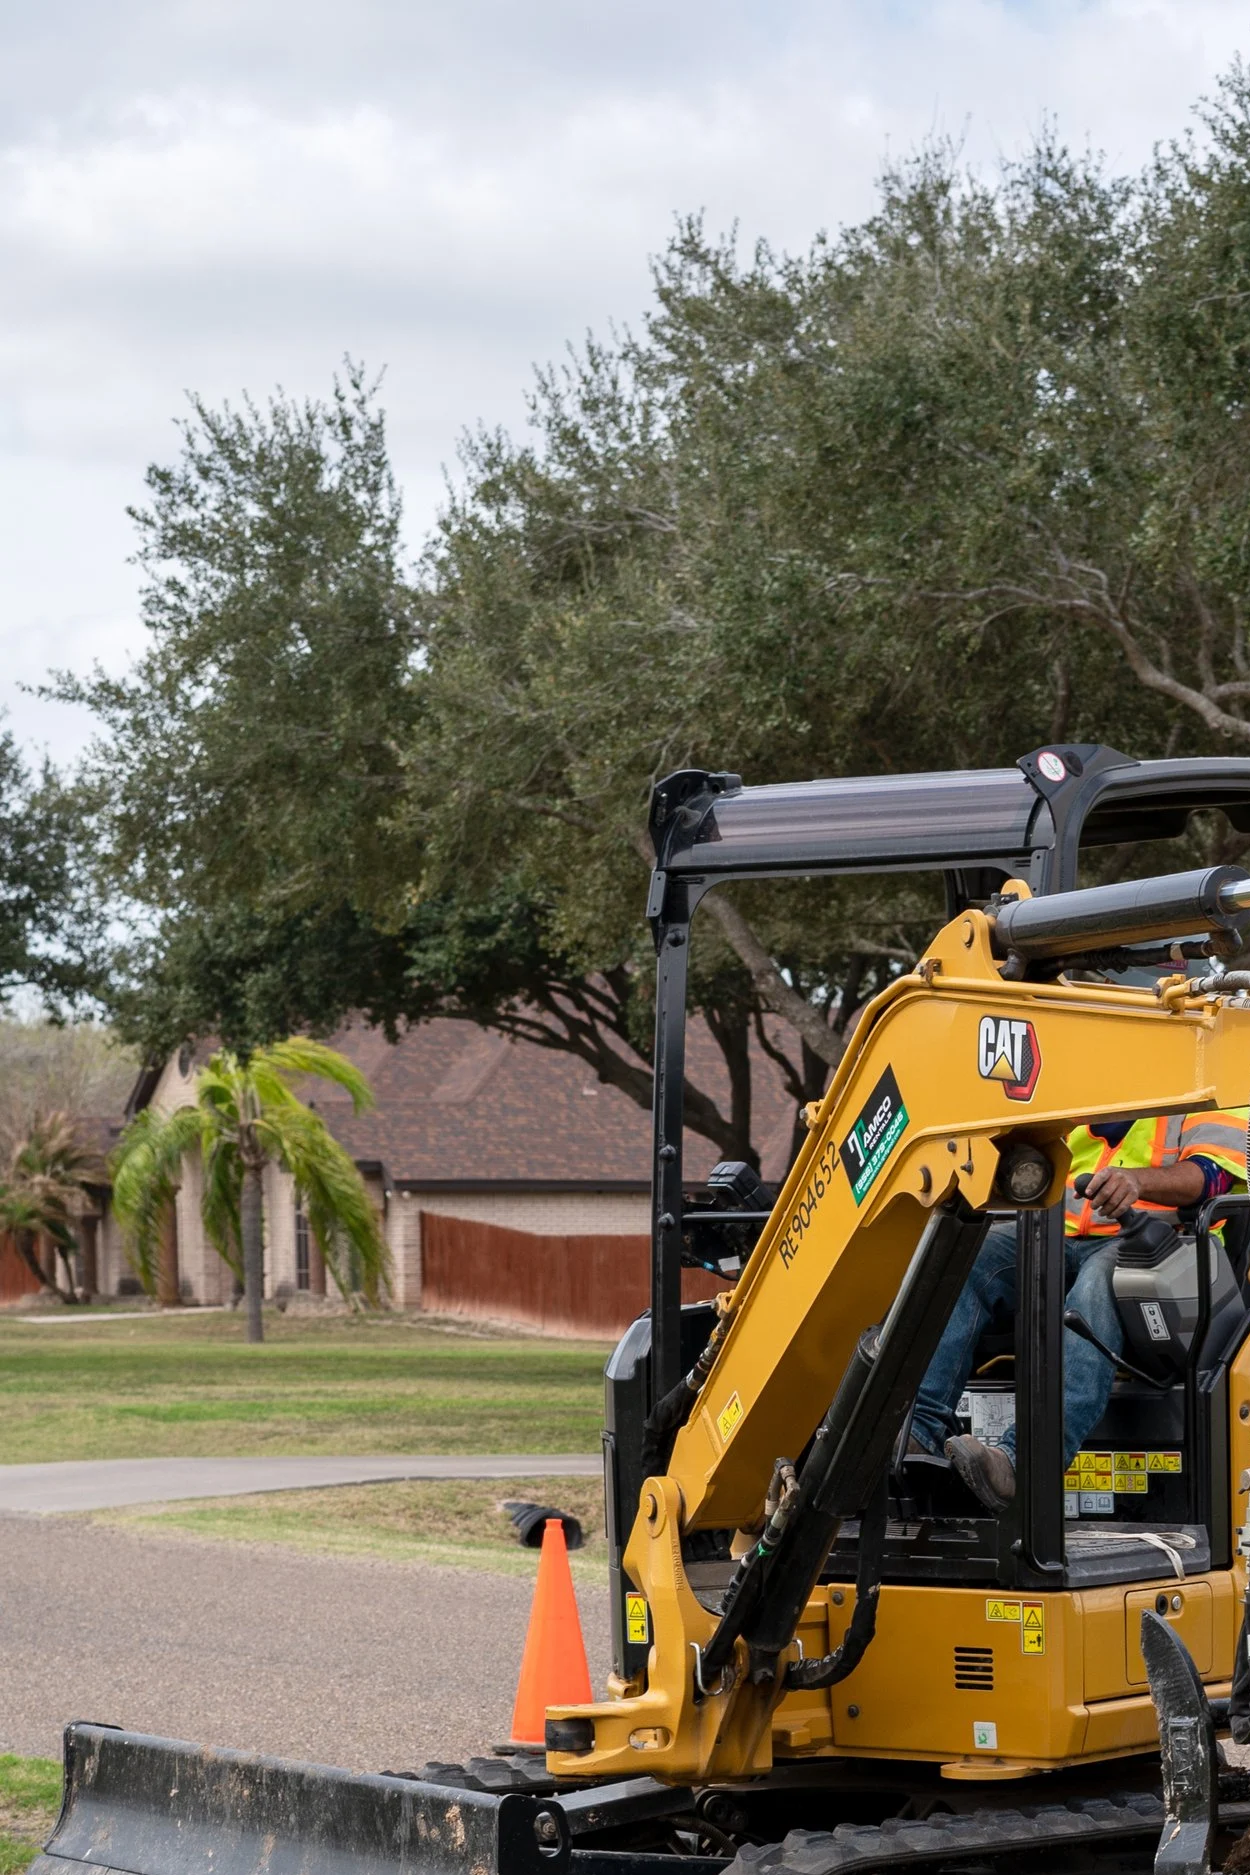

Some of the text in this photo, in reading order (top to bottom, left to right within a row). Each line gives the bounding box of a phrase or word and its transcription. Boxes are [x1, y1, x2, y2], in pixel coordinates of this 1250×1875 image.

[979, 1016, 1028, 1081] CAT
[868, 1110, 893, 1151] RENTALS
[778, 1140, 841, 1270] RE904652
